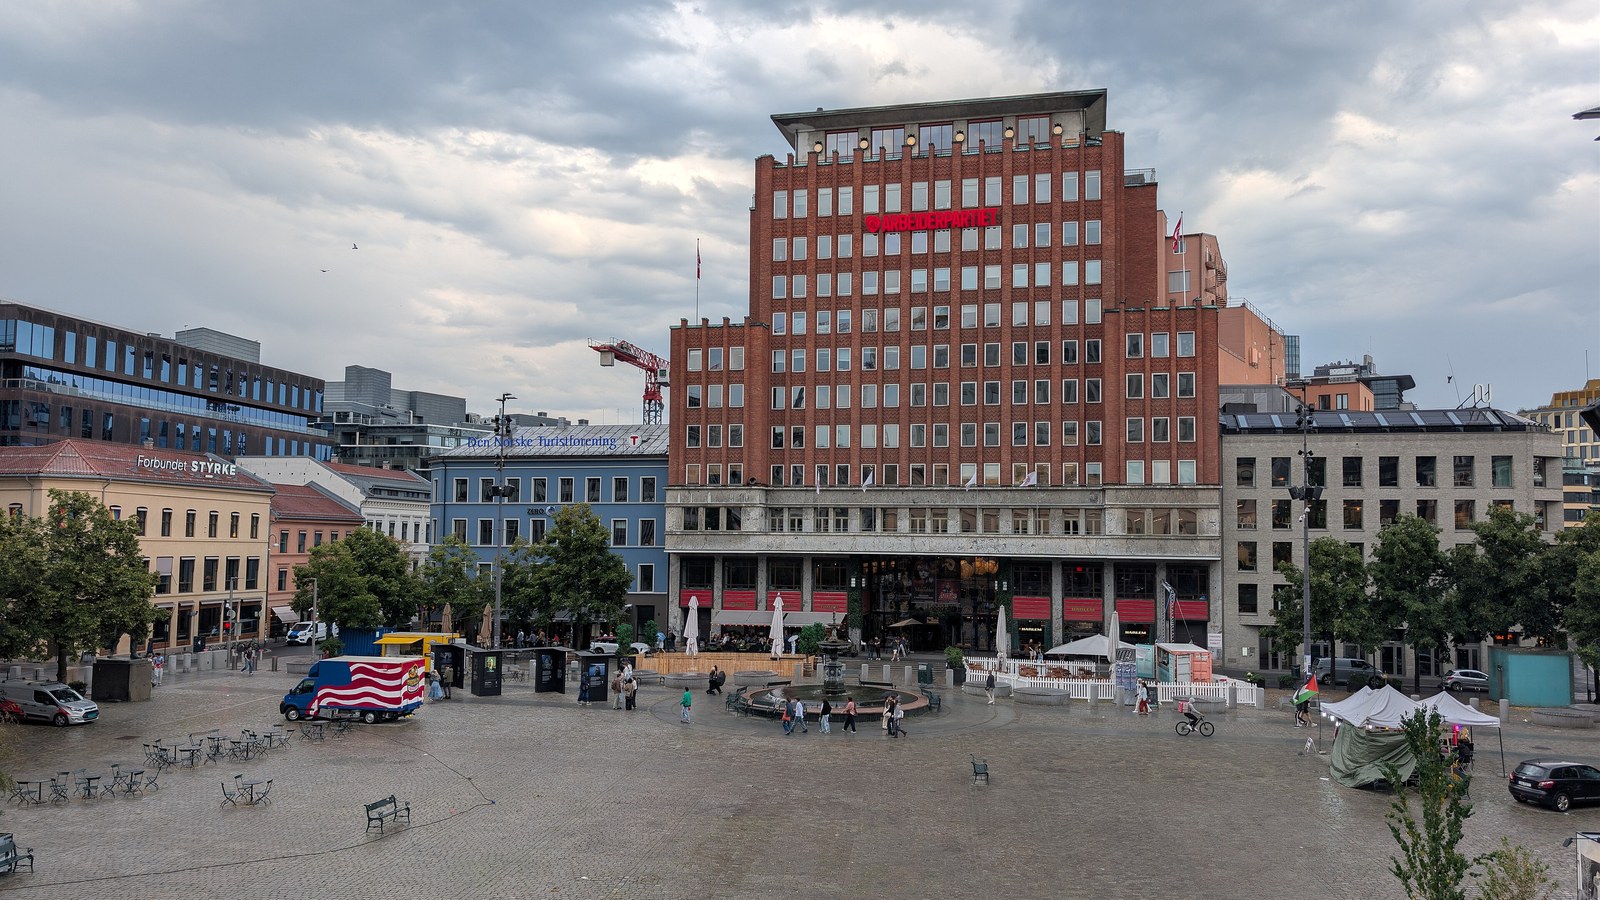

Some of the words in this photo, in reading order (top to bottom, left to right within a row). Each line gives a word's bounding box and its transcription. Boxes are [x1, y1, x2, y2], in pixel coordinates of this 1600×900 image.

[881, 208, 998, 232] ARBEIDERPARTIET
[467, 436, 490, 448] Den
[494, 435, 533, 447] Norske
[539, 435, 617, 451] Turistforening
[137, 454, 187, 472] Forbundet
[191, 459, 237, 476] STYRKE
